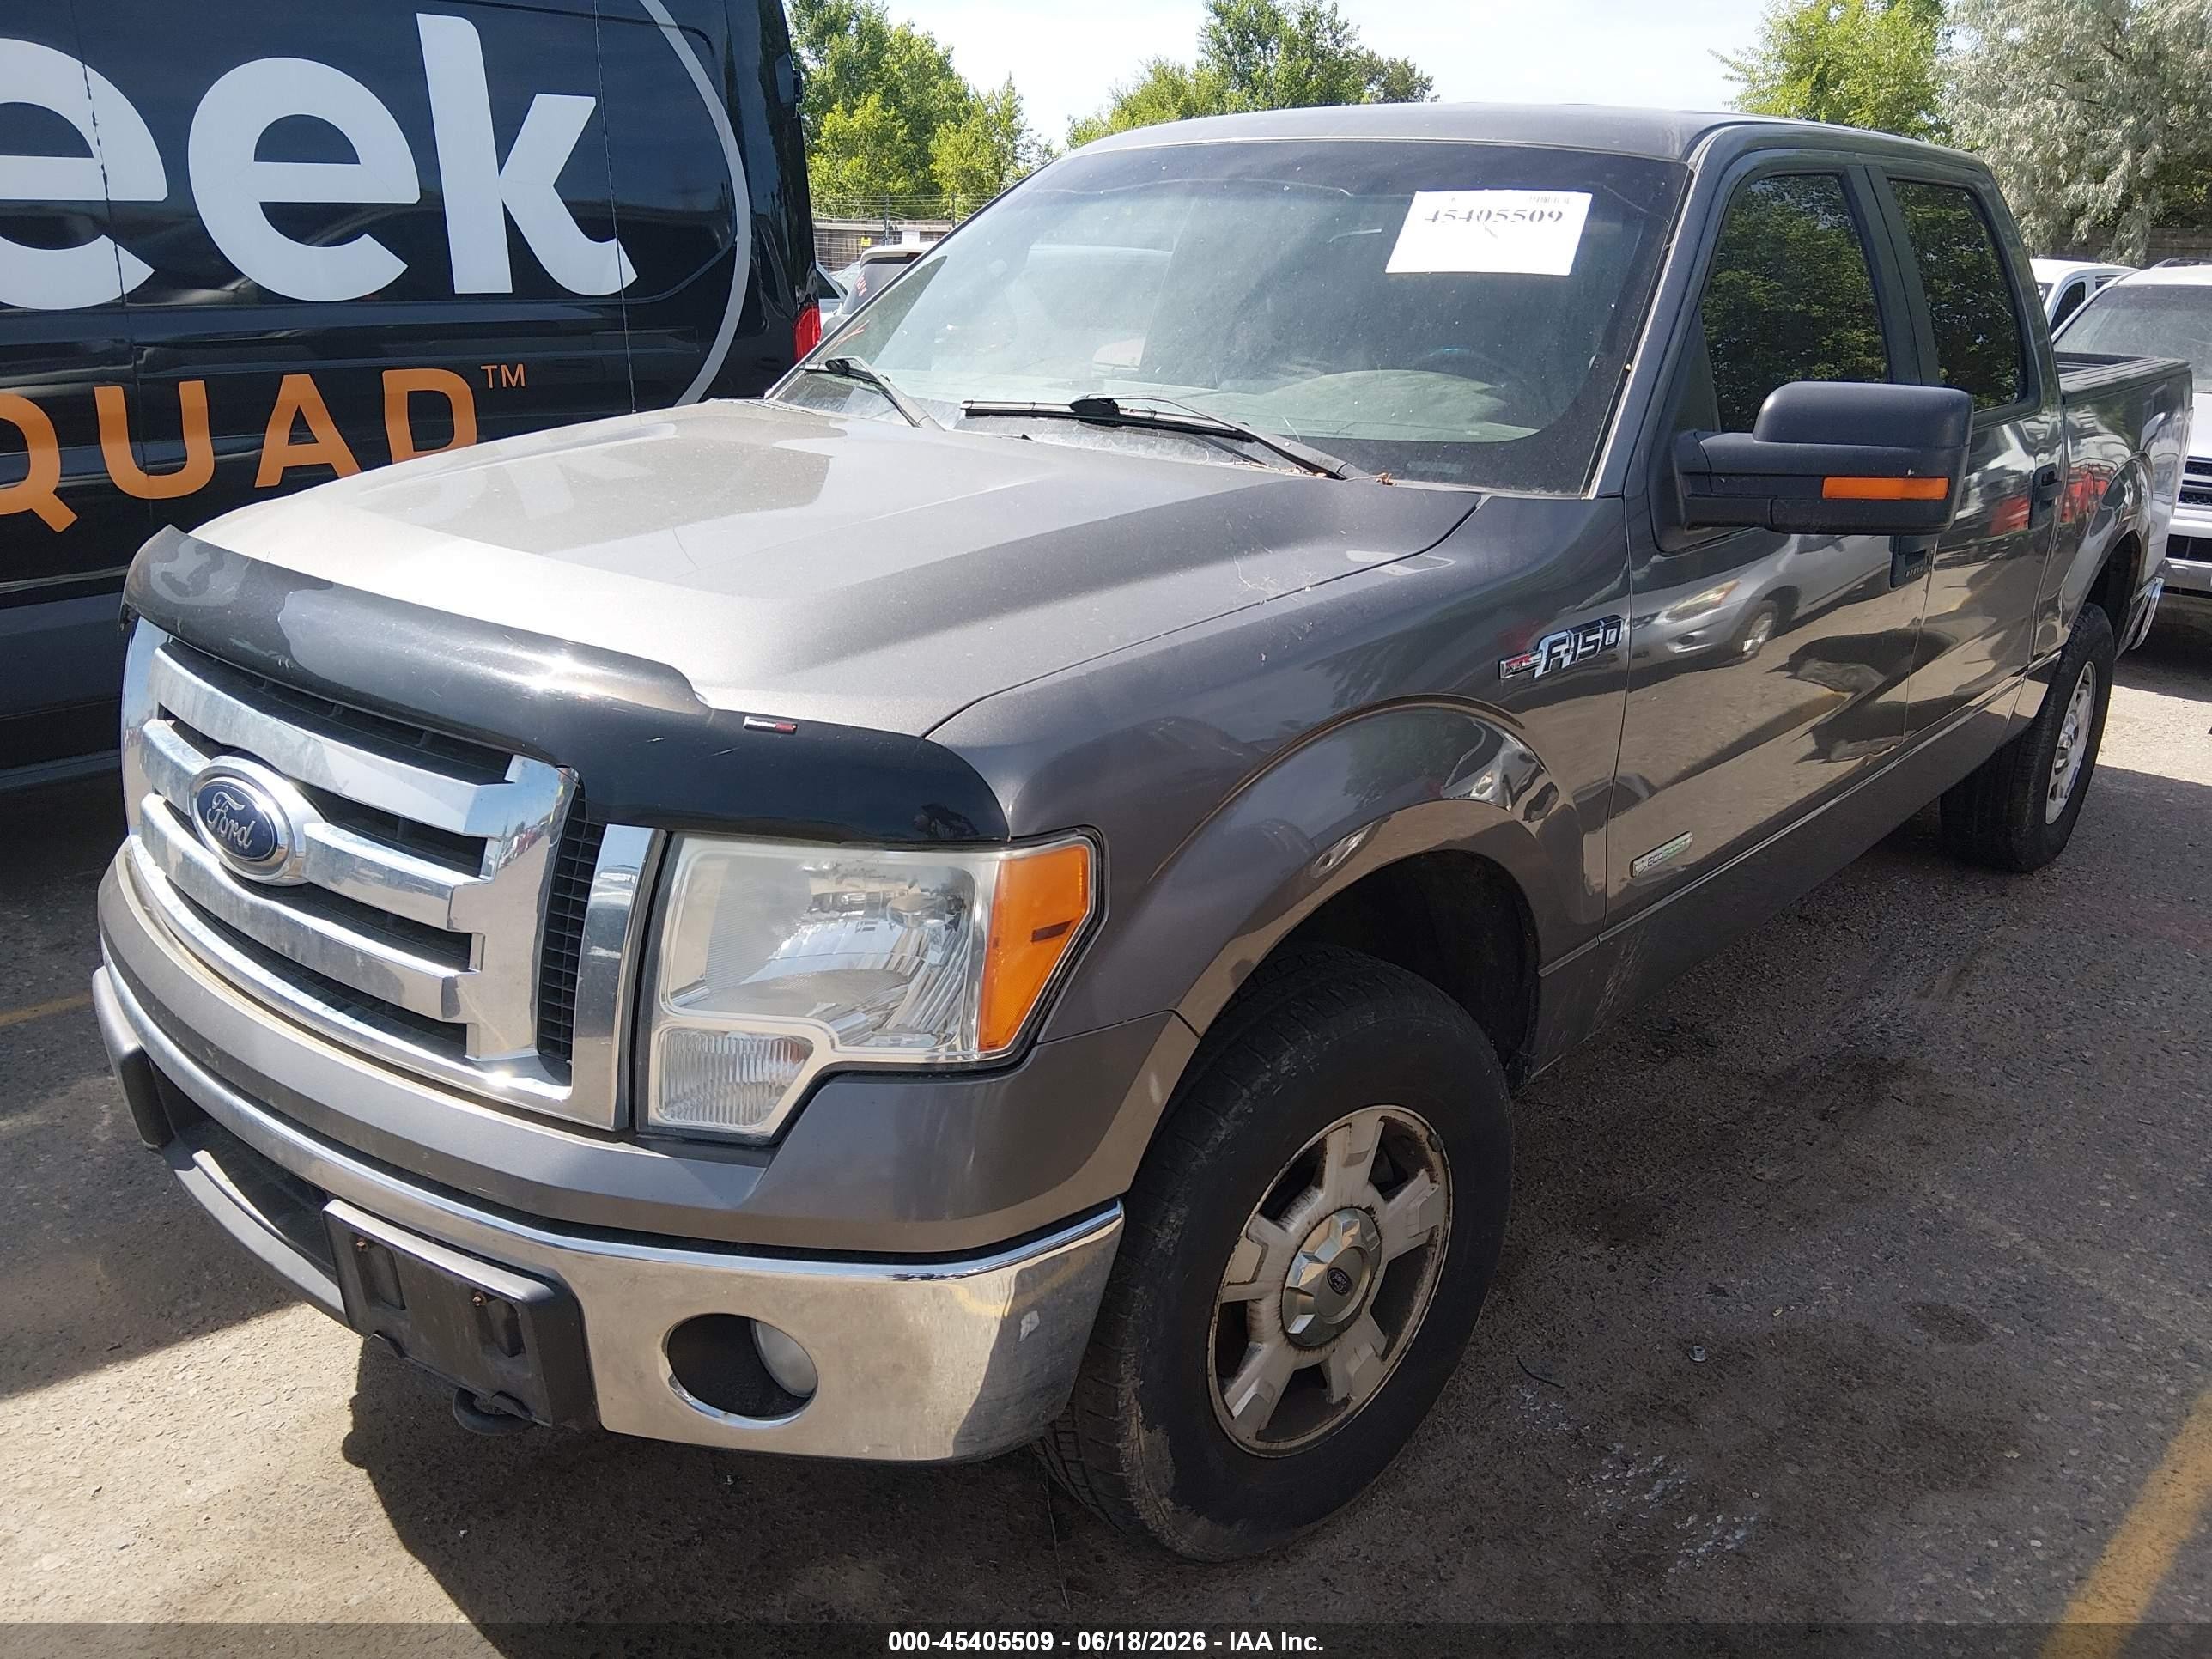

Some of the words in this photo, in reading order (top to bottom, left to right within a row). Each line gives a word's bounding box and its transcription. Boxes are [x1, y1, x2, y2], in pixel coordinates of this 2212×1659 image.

[1424, 209, 1564, 223] 45405509
[481, 364, 526, 388] TM
[206, 791, 256, 850] Ford
